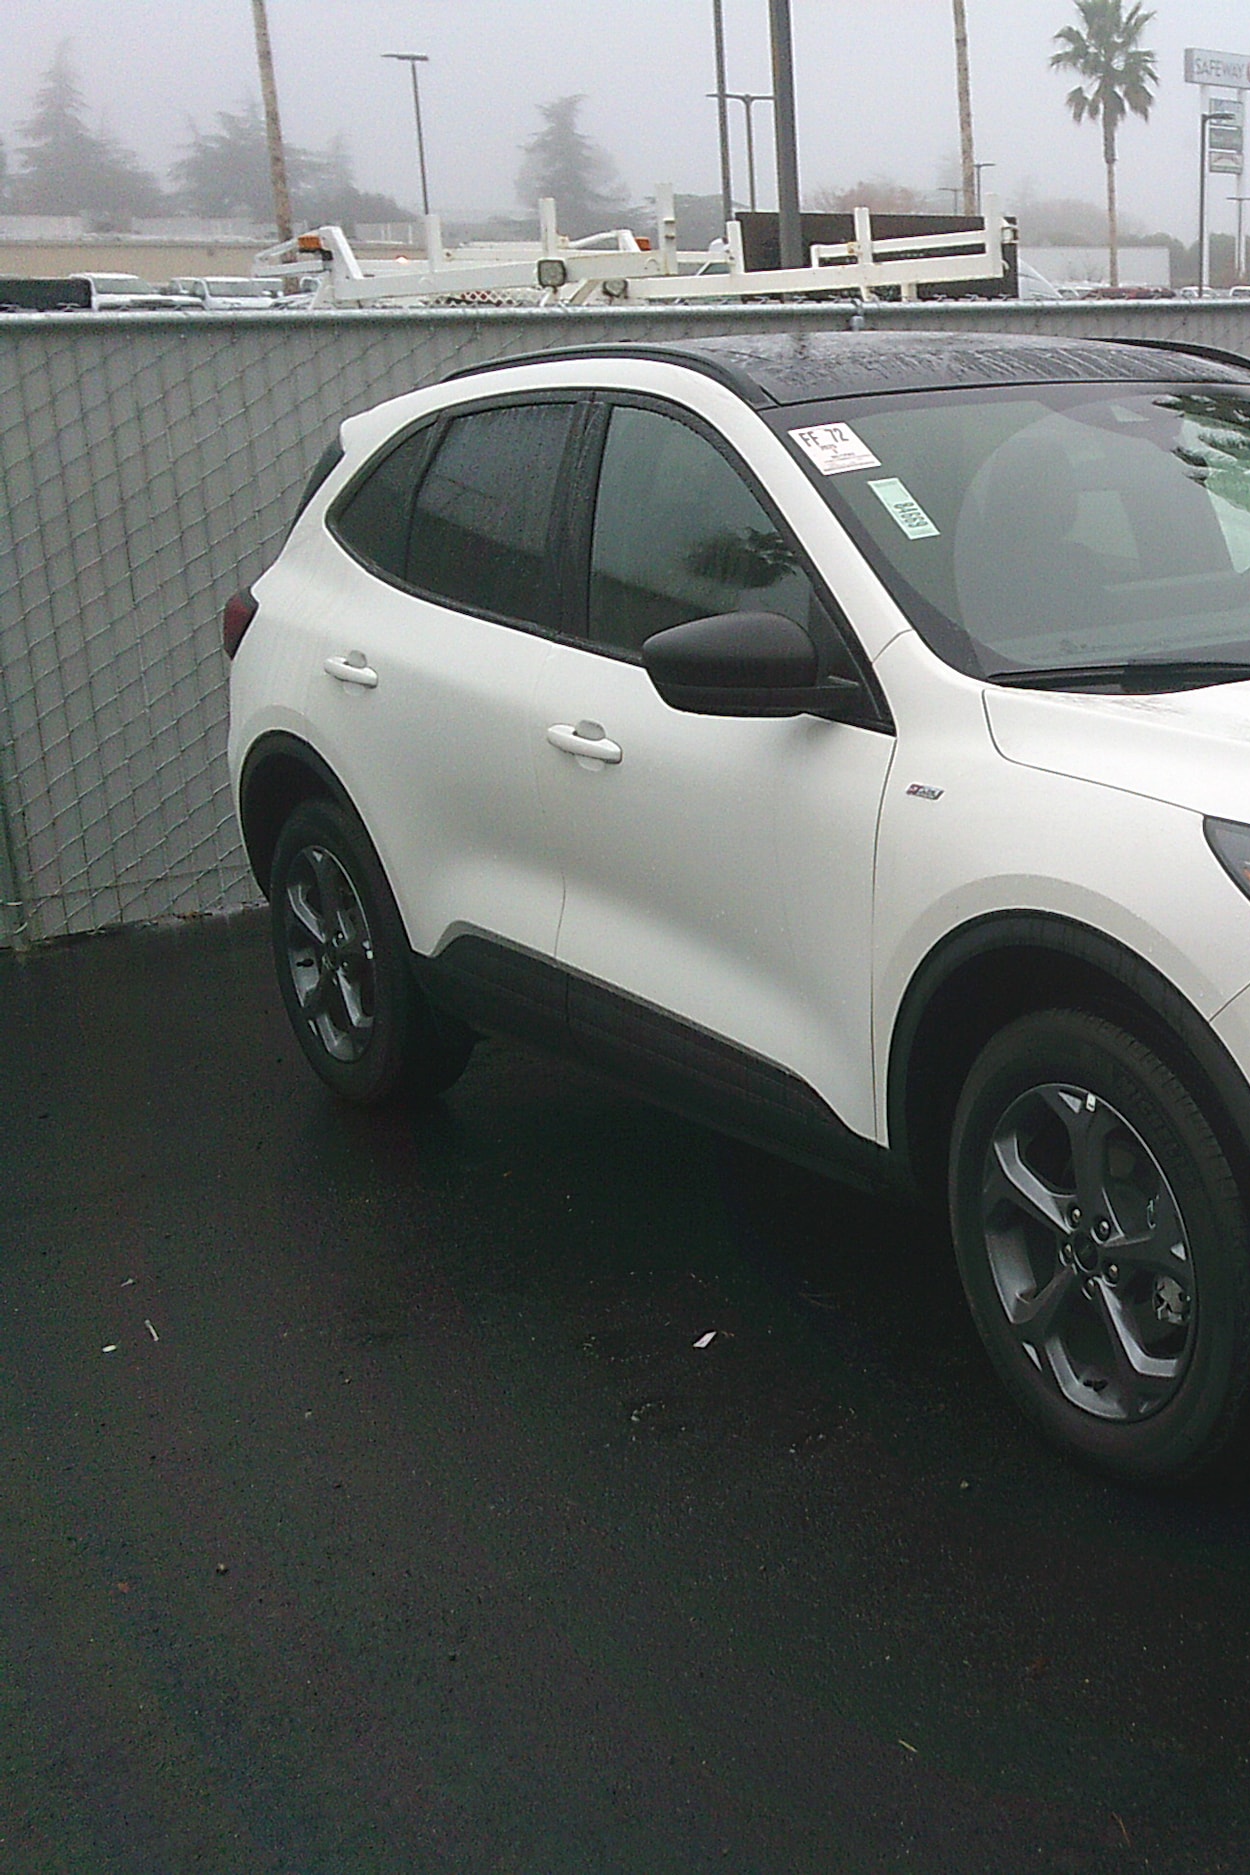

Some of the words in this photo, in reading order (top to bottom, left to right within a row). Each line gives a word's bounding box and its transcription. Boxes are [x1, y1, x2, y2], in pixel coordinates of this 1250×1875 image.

[1194, 57, 1245, 78] SAFEWAY
[799, 431, 820, 447] FF
[824, 428, 849, 443] 72
